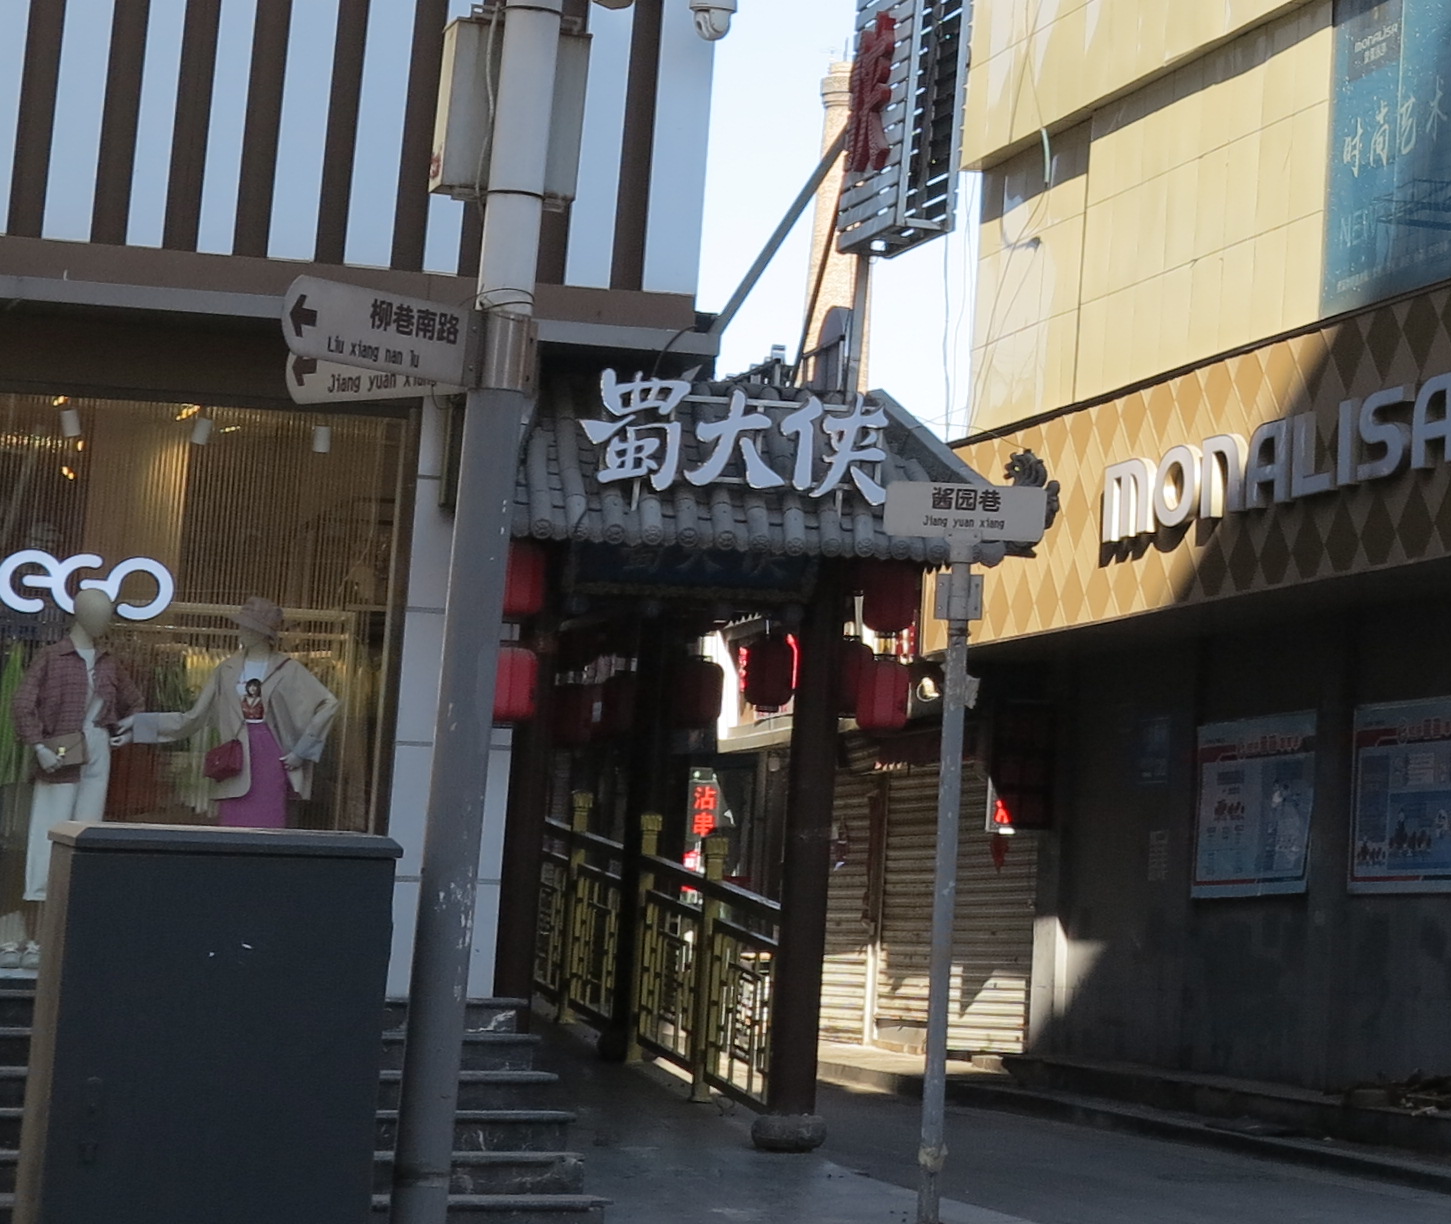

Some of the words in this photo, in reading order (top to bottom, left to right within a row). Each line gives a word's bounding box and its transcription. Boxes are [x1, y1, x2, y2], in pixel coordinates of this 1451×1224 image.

[369, 298, 459, 345] 柳巷南路
[327, 336, 344, 354] Liu
[350, 341, 379, 362] xiang
[385, 349, 403, 366] nan
[327, 374, 360, 393] Jiang
[579, 368, 888, 507] 蜀大侠
[932, 487, 1001, 512] 酱园巷
[923, 515, 948, 528] Jiang
[952, 518, 974, 529] yuan
[979, 517, 1005, 530] xiang
